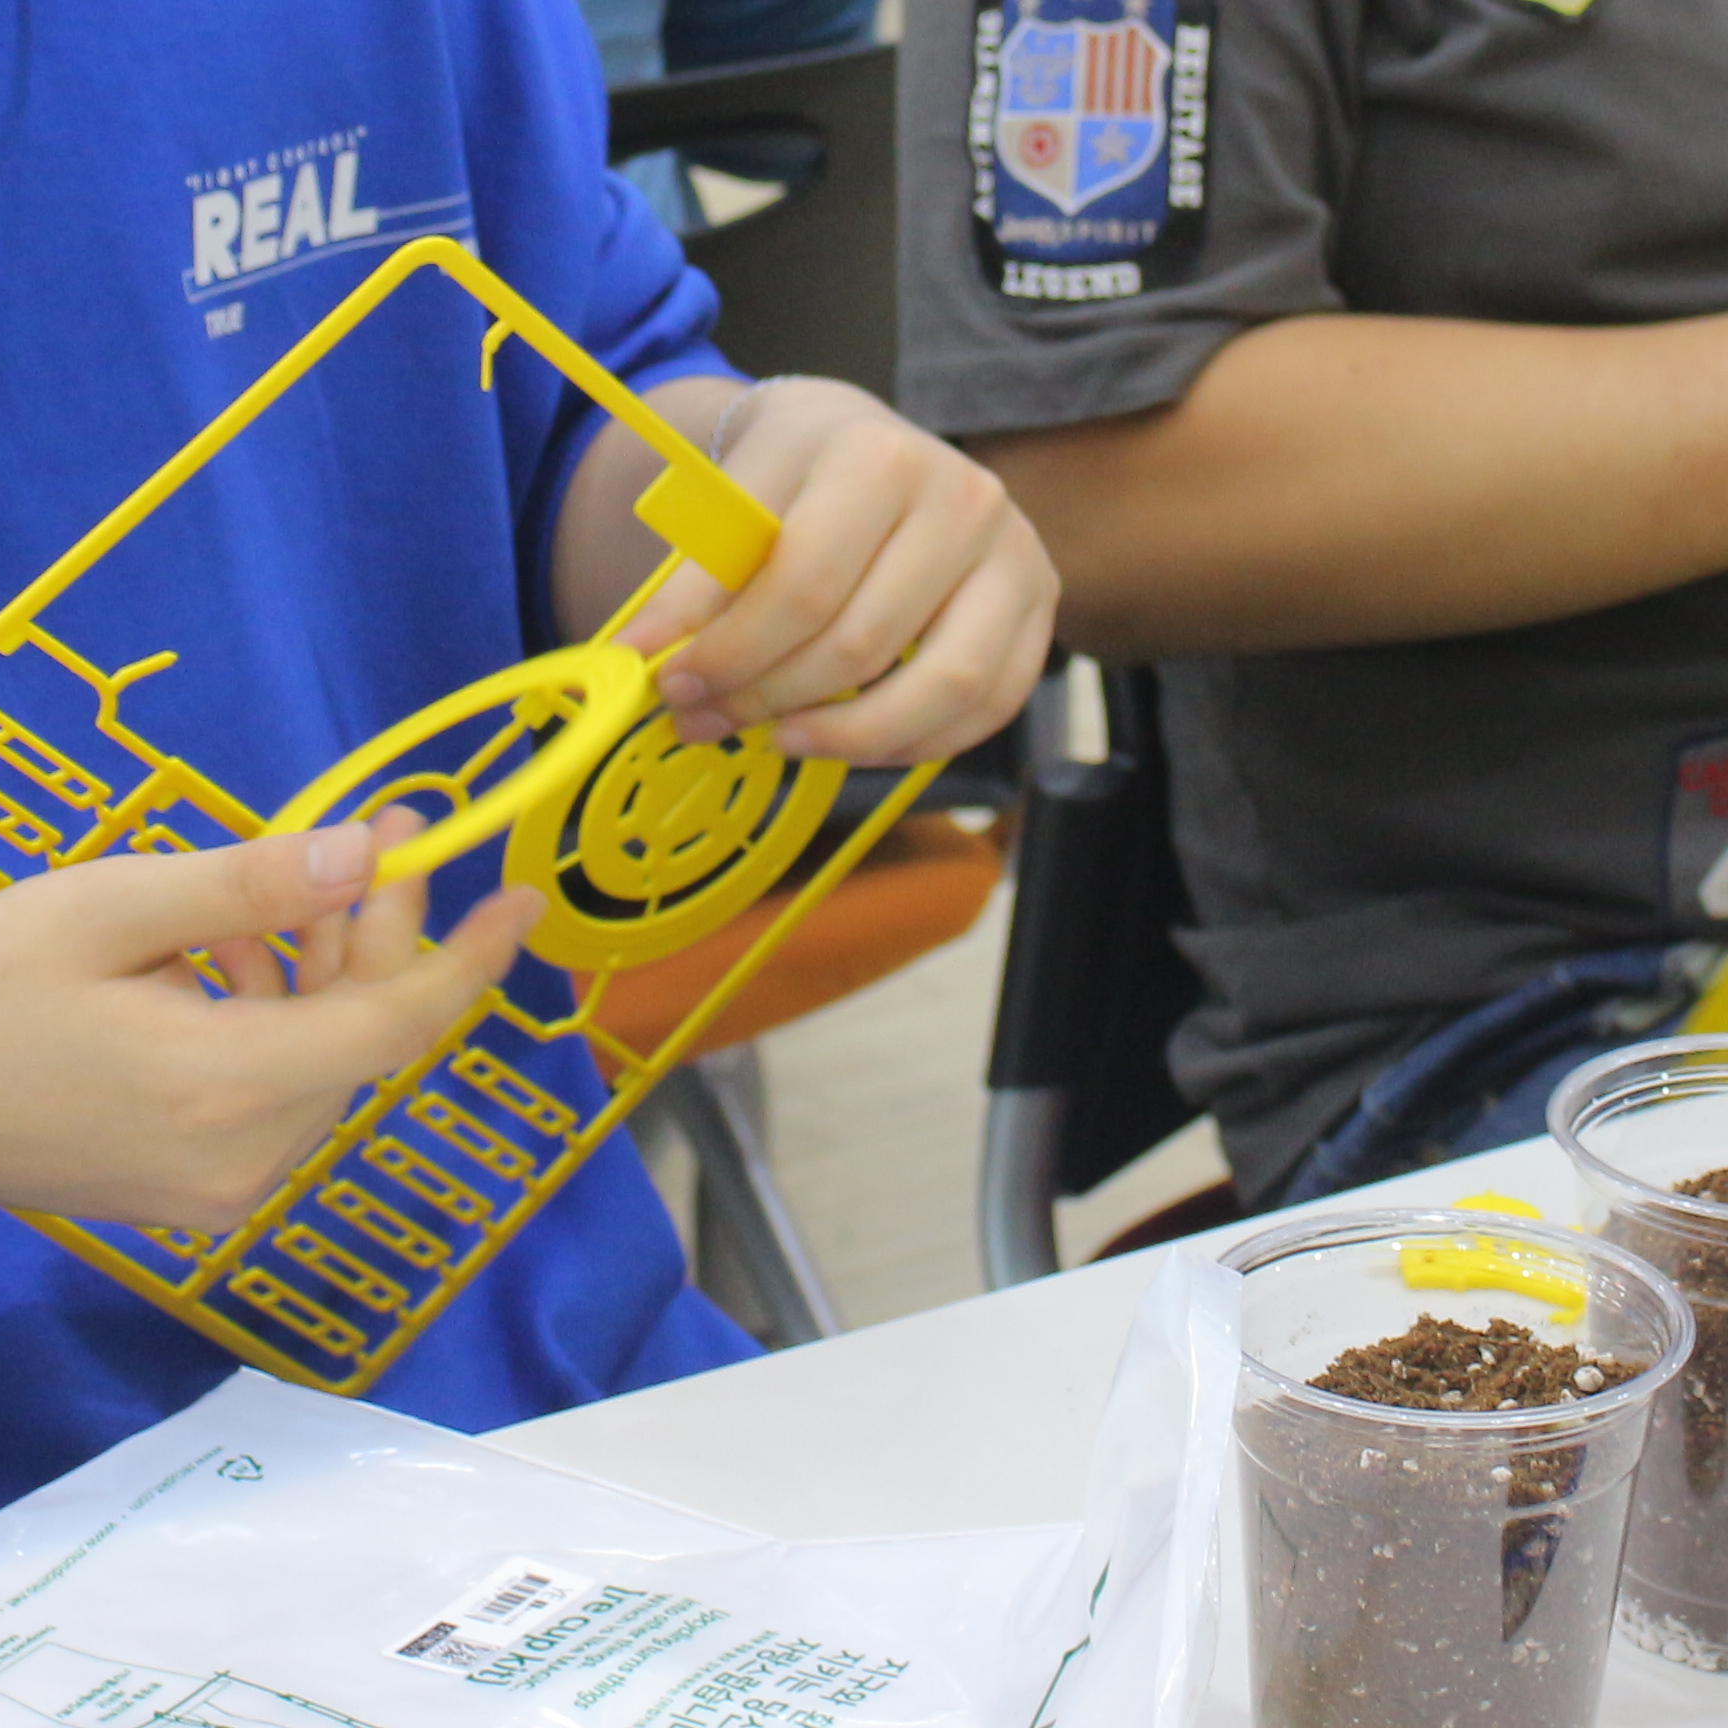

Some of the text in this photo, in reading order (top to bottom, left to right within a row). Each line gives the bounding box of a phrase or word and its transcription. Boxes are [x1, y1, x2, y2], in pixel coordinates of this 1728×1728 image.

[1169, 25, 1210, 208] HERITAGE
[192, 150, 379, 287] REAL
[1002, 261, 1141, 301] LEGEND
[522, 1615, 591, 1652] cup
[574, 1609, 731, 1709] Upcycling turns things
[775, 1649, 866, 1693] 지키는
[820, 1657, 911, 1707] 지구와
